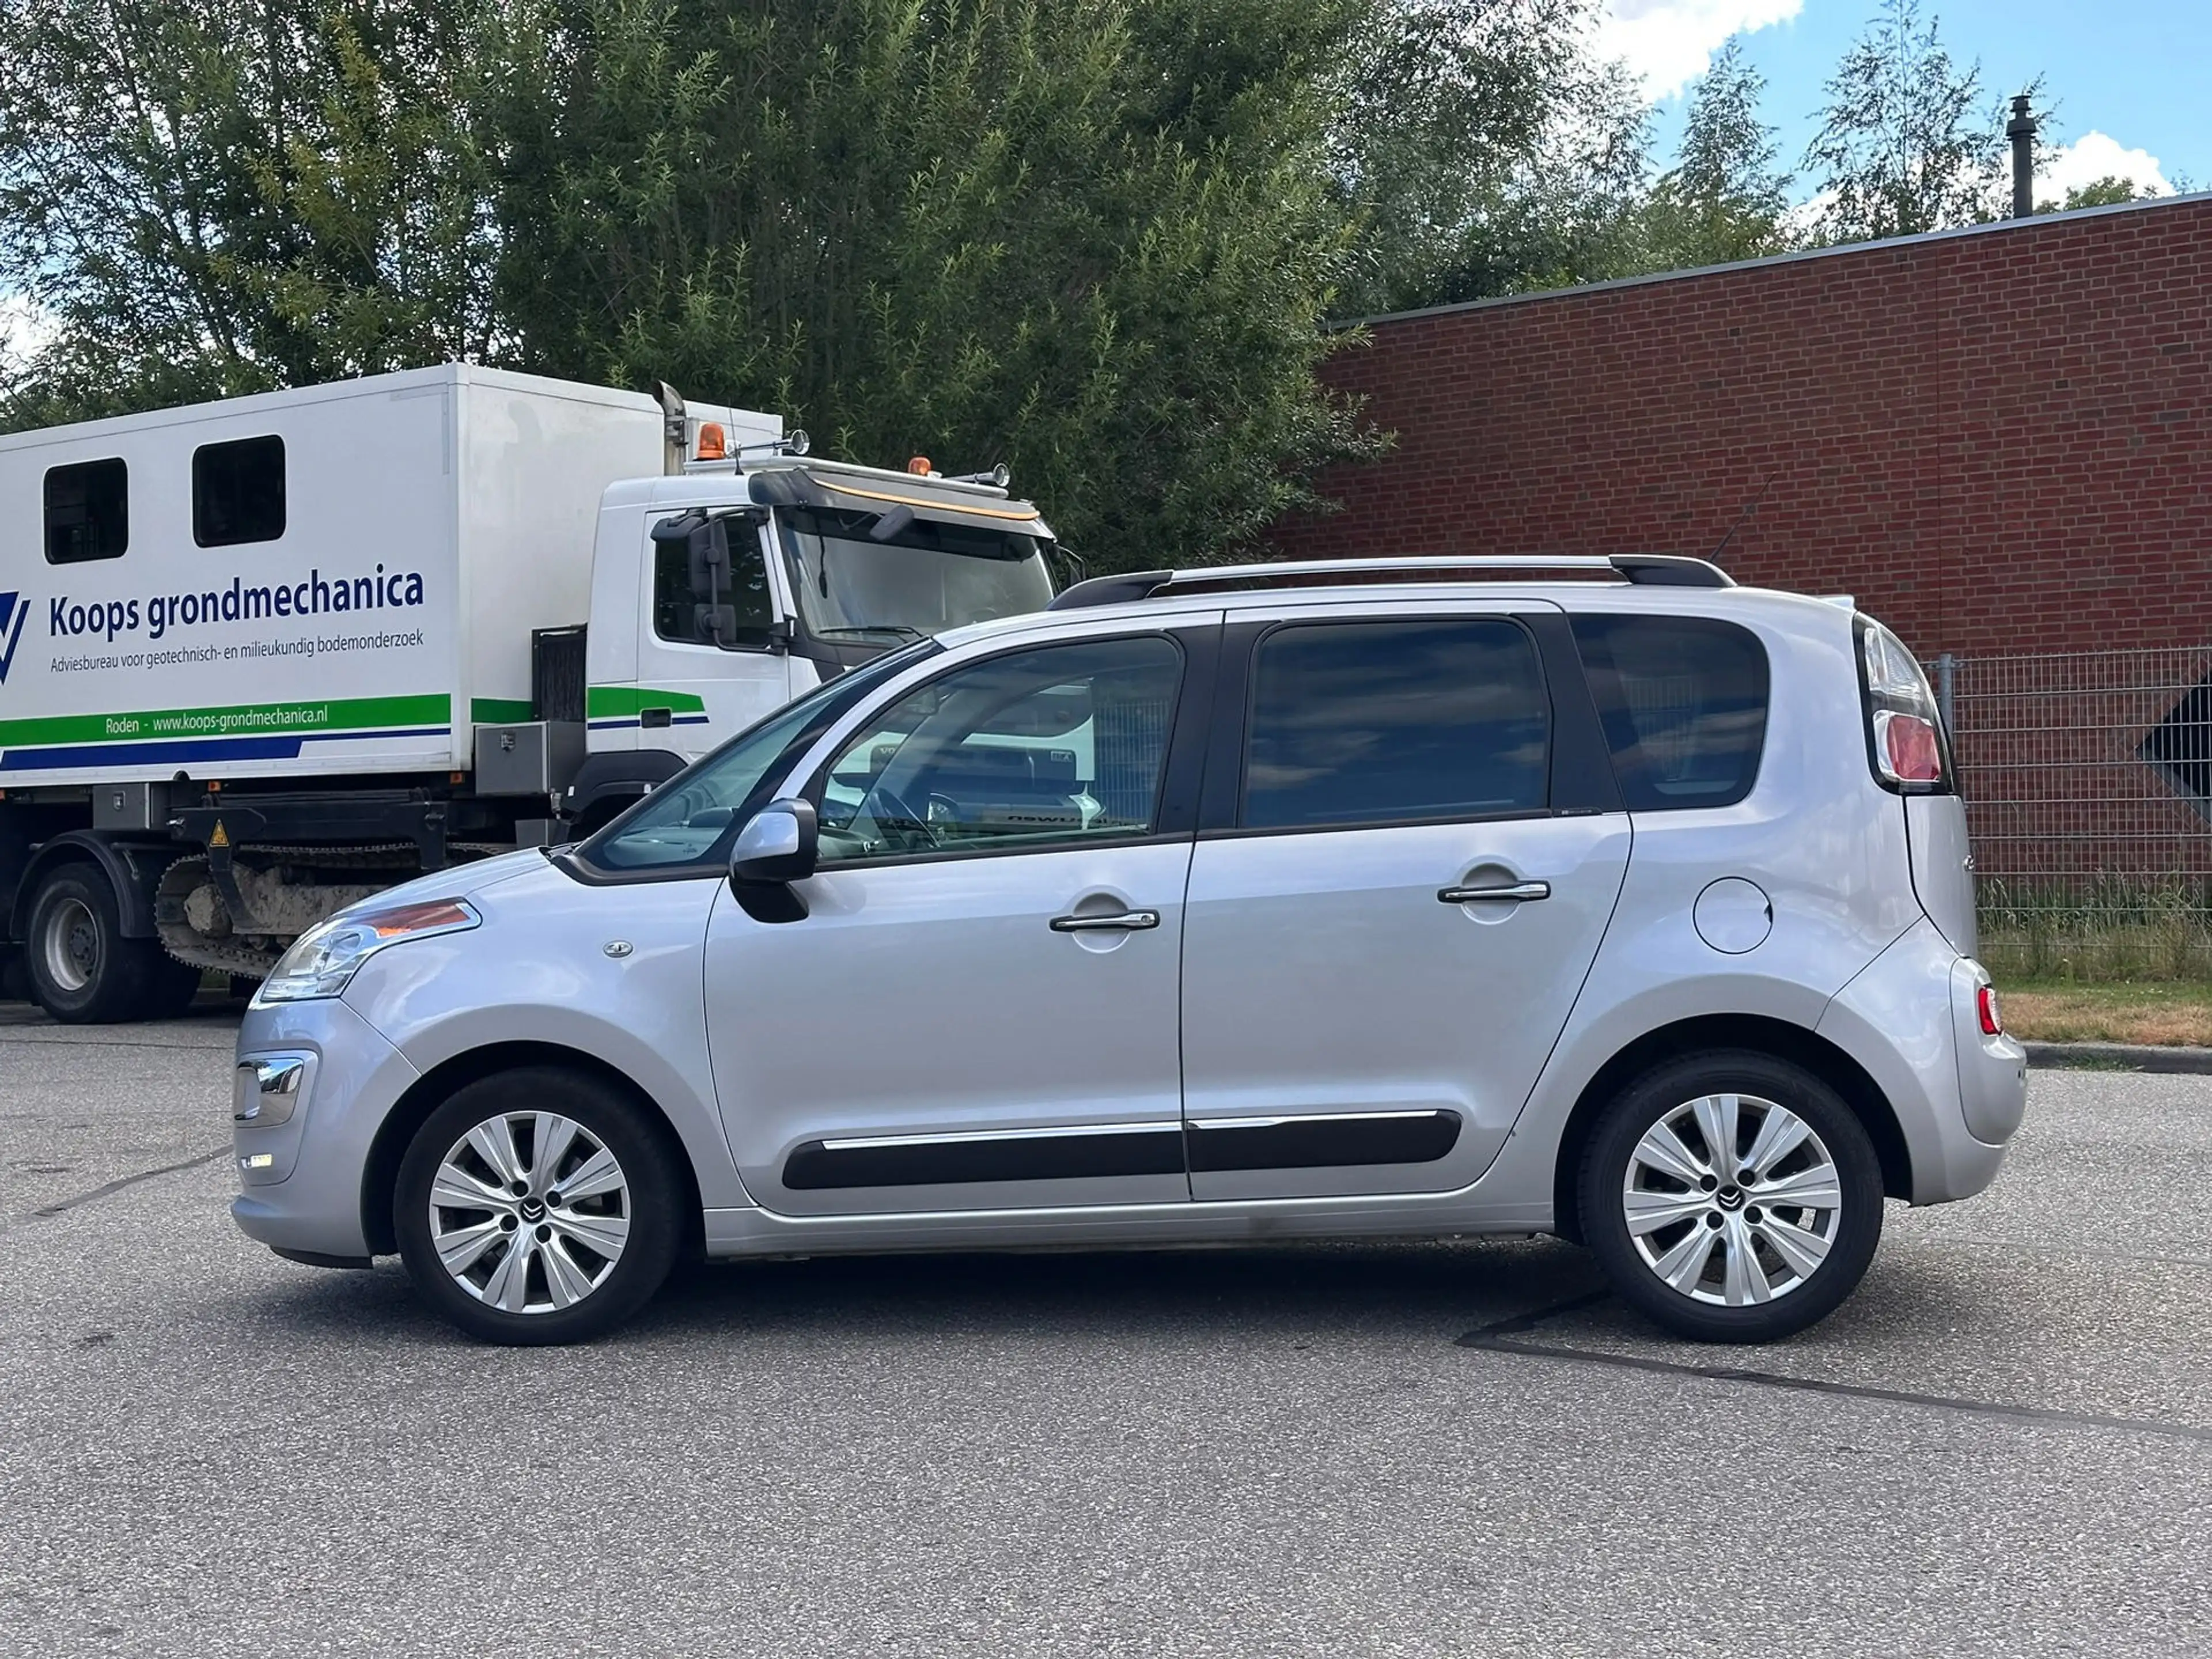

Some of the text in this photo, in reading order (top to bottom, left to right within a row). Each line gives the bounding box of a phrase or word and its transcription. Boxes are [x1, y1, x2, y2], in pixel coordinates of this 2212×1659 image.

[50, 563, 423, 642] Koops grondmechanica
[50, 628, 423, 673] Adviesbureau voor geotechnisch- en milieukundig bodemonderzoek
[107, 718, 139, 733] Roden
[153, 704, 328, 732] www.koops-grondmechanica.nl
